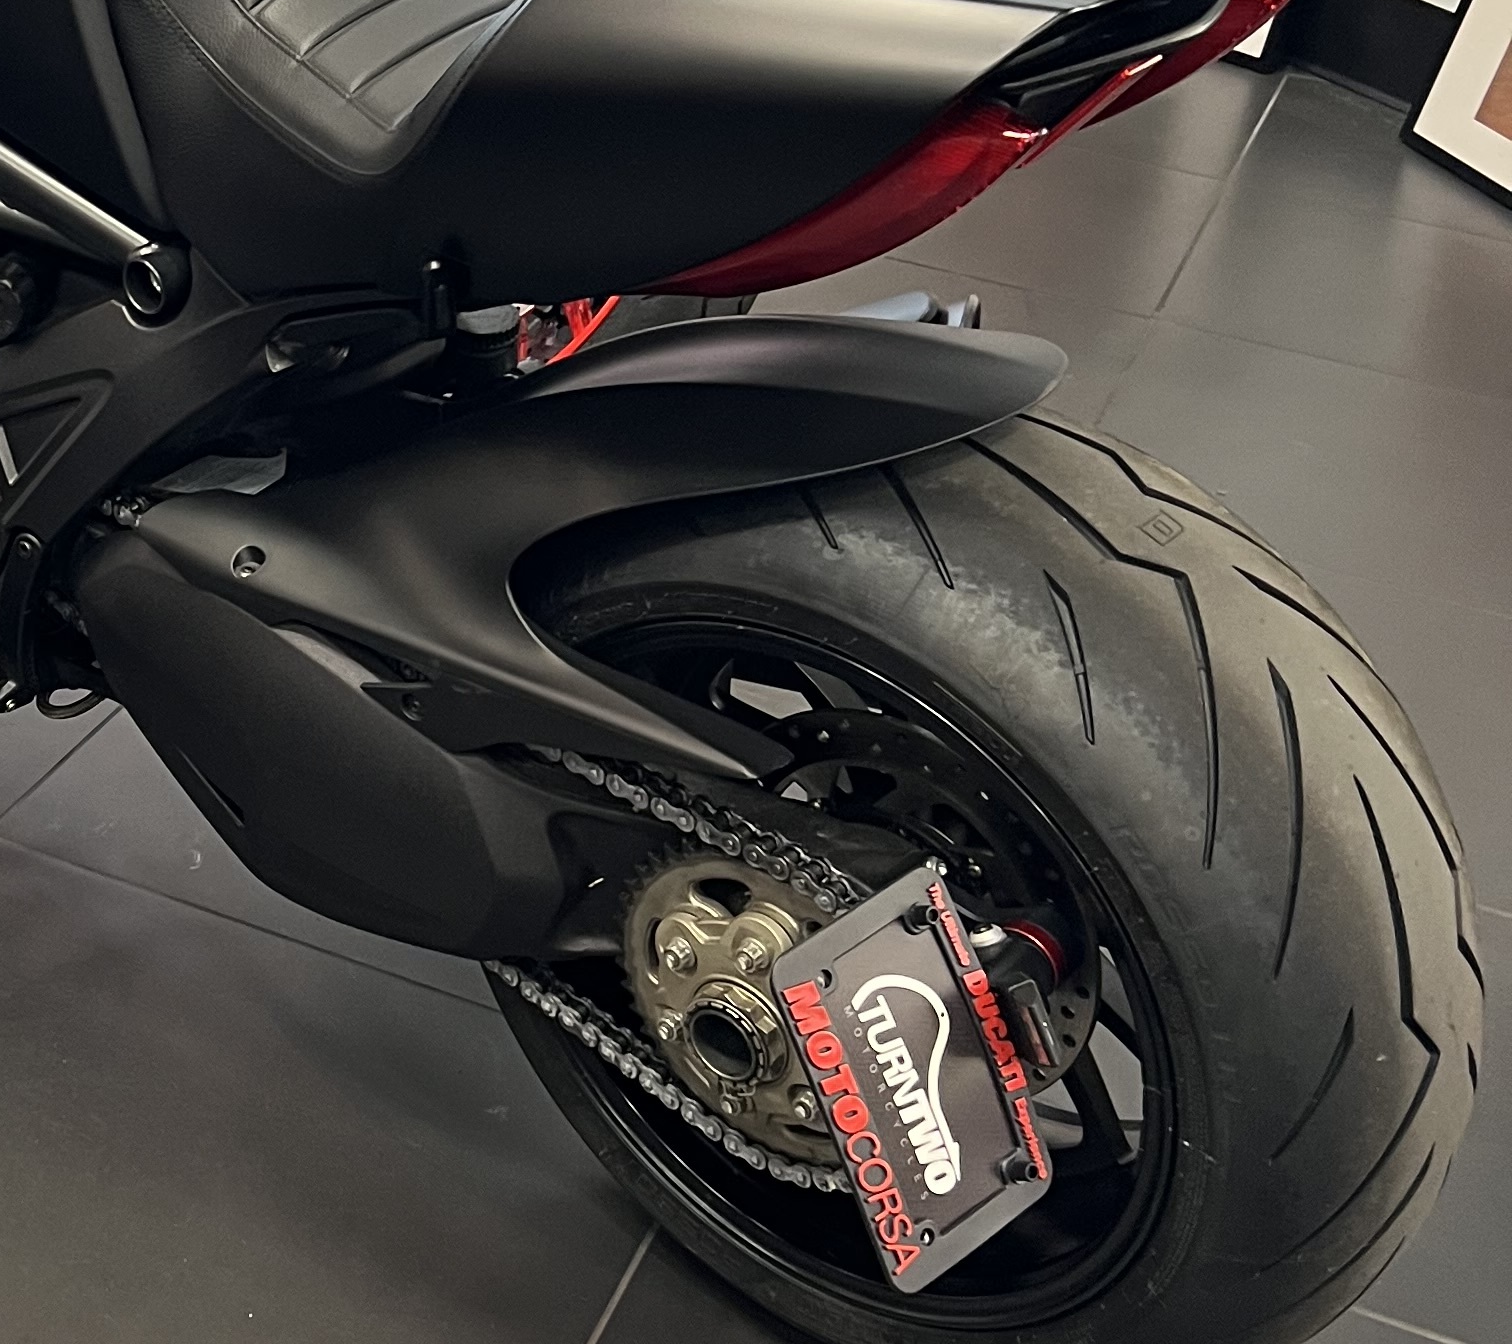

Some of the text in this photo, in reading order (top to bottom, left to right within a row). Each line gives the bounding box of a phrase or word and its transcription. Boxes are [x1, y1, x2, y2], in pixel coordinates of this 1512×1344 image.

[782, 980, 921, 1276] MOTOCORSA
[843, 1004, 930, 1201] MOTORCYCLES
[857, 994, 957, 1195] TURNTWO
[963, 969, 1027, 1092] DUCATI
